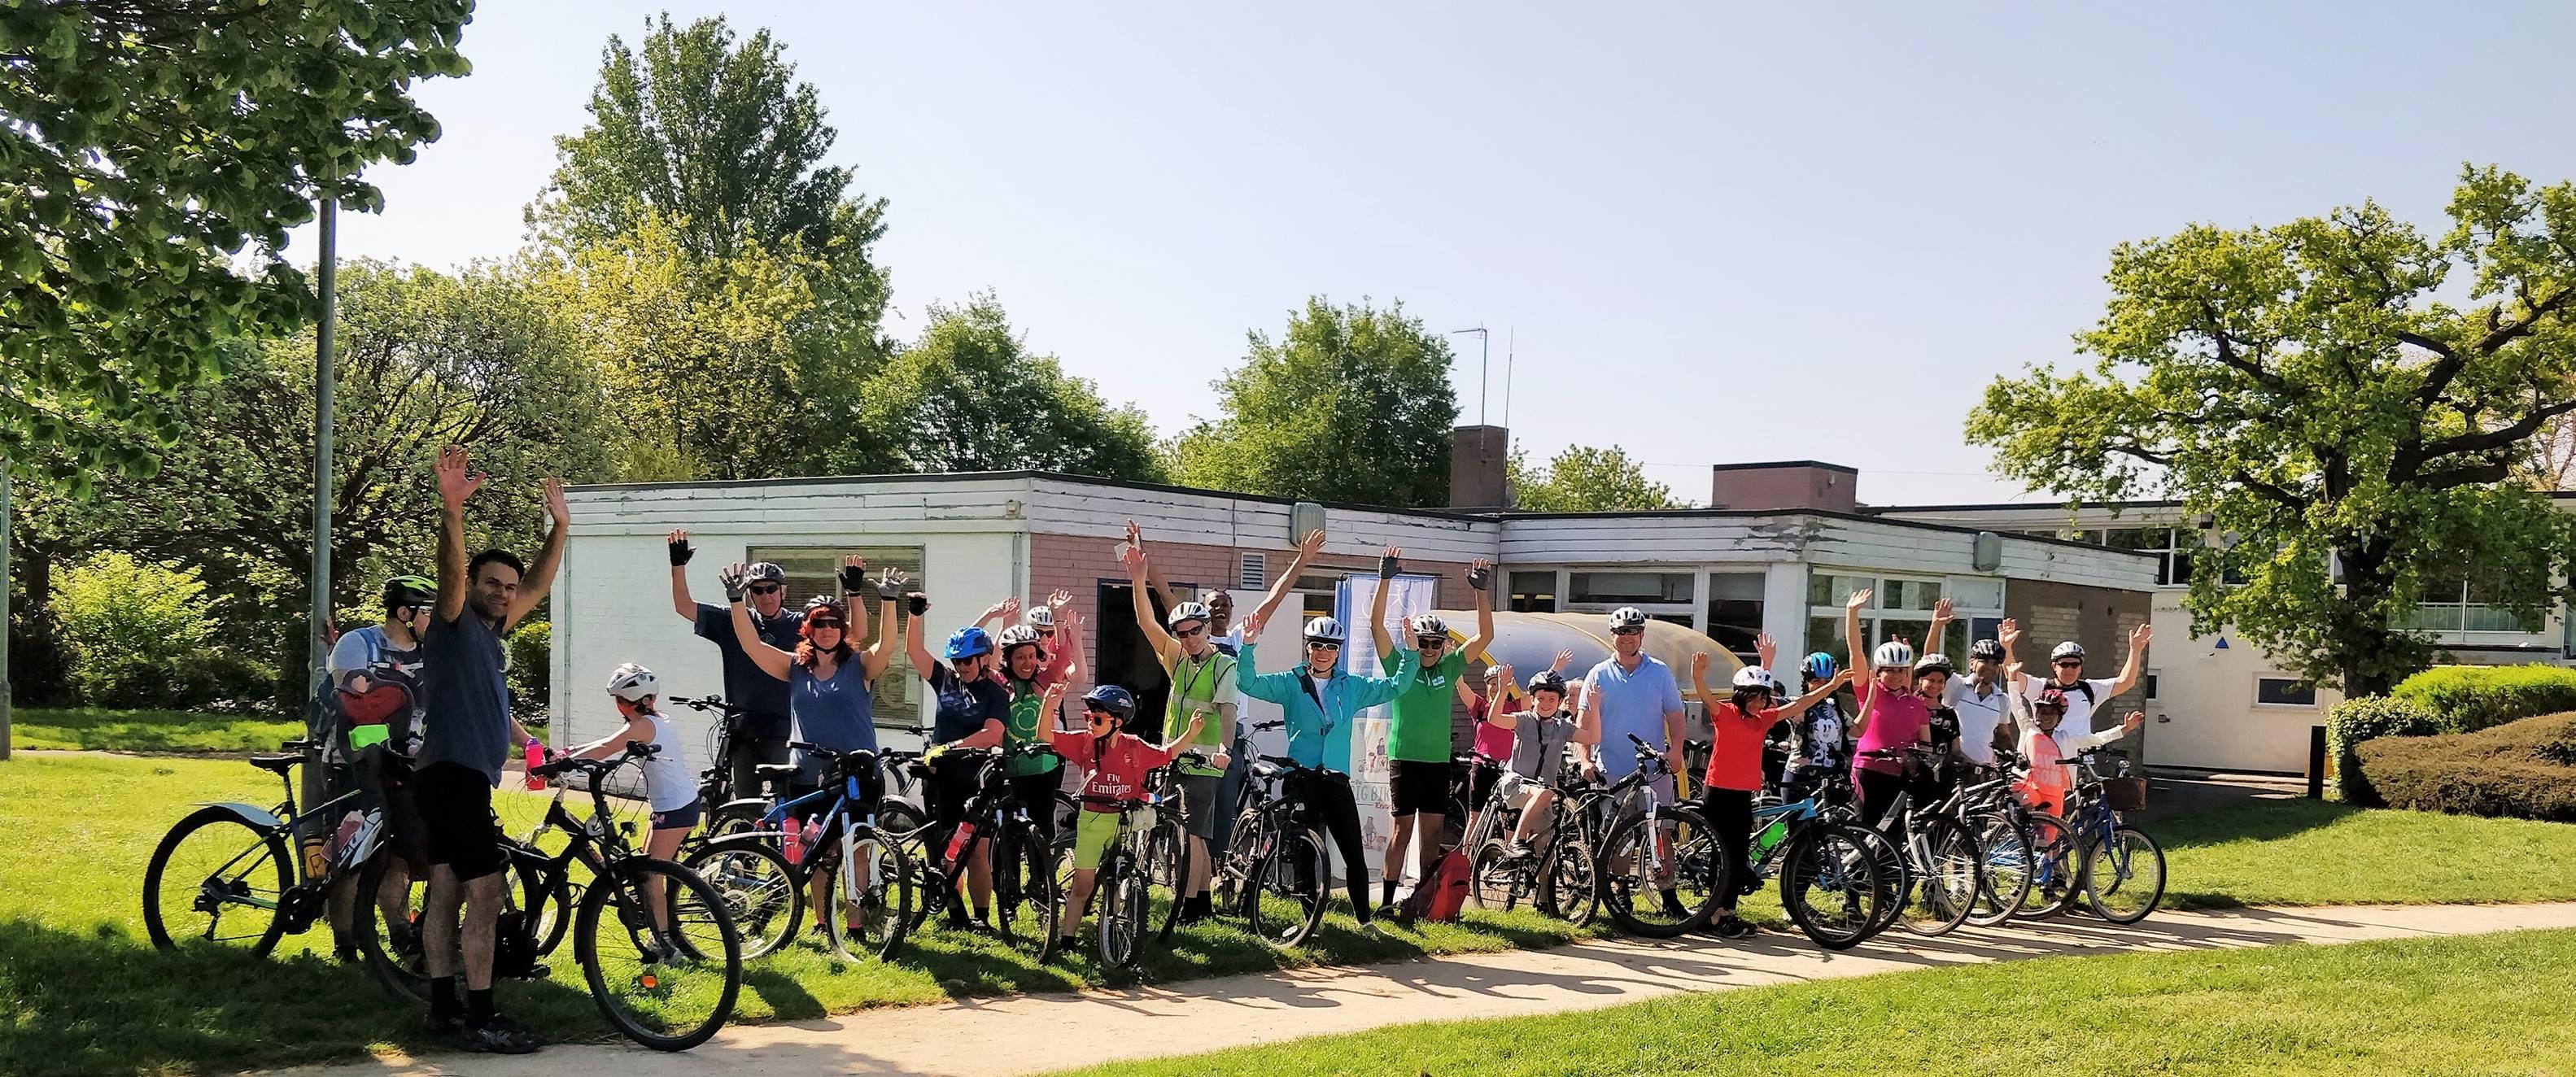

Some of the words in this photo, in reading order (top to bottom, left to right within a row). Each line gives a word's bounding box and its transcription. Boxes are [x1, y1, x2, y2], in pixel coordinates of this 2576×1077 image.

[1107, 774, 1120, 783] Fly
[1092, 781, 1132, 795] Emirates
[1371, 786, 1391, 802] BIK
